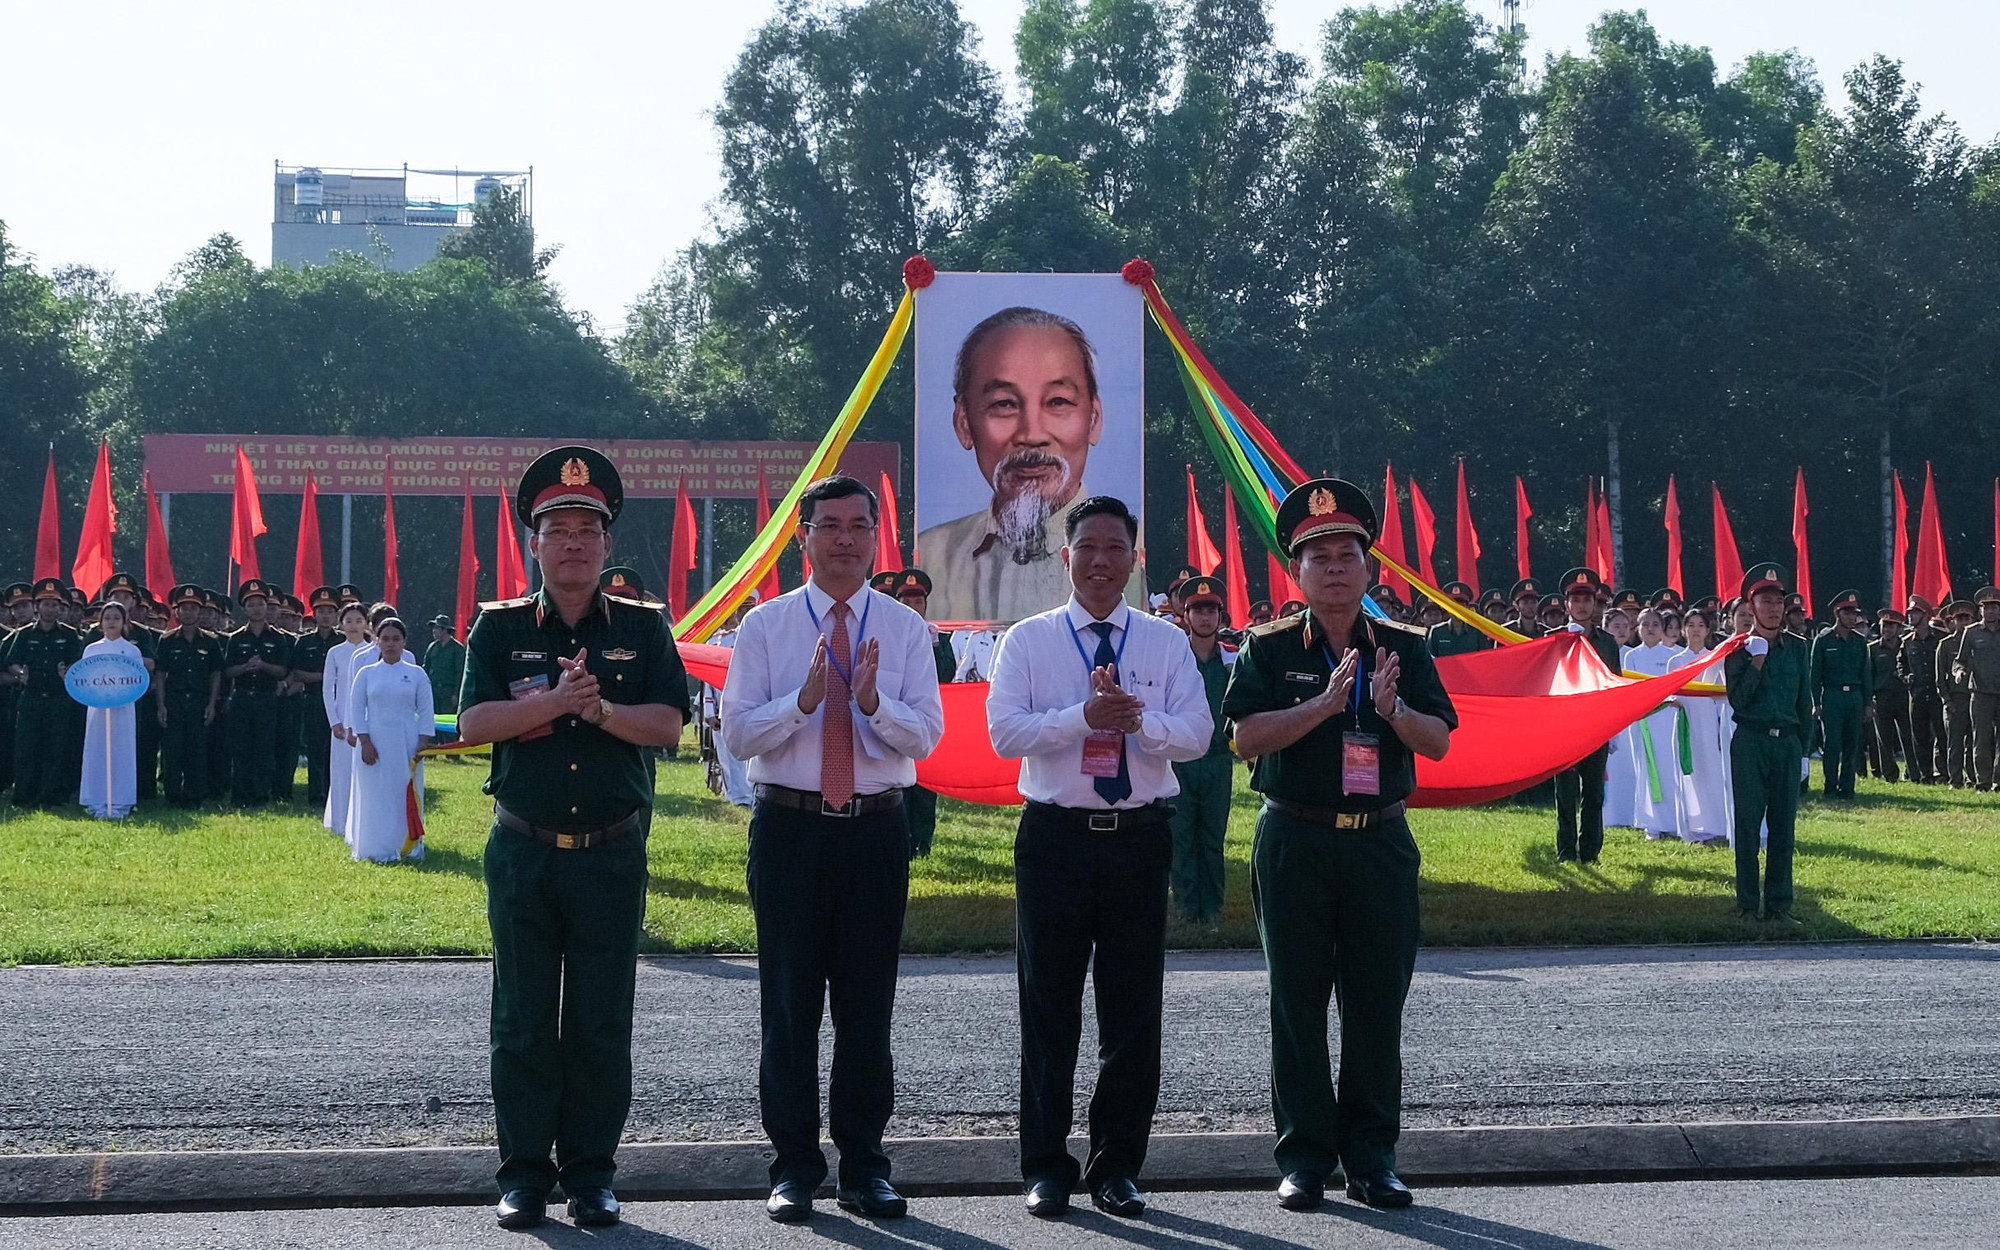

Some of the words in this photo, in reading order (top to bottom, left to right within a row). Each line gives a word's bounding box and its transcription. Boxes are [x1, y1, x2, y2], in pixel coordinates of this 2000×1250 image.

[275, 443, 319, 456] LIỆT
[326, 442, 383, 454] CHÀO
[390, 443, 455, 456] MỪNG
[462, 444, 504, 457] CÁC
[626, 446, 683, 460] ĐỘNG
[691, 447, 738, 459] VIÊN
[745, 448, 803, 460] THAM
[336, 459, 386, 470] GIÁO
[394, 460, 436, 473] DỤC
[444, 458, 500, 472] QUỐC
[621, 463, 649, 474] AN
[657, 463, 709, 474] NINH
[716, 463, 757, 476] HỌC
[764, 463, 804, 475] SIN
[210, 474, 283, 485] TRNG
[390, 474, 461, 487] THÔNG
[688, 479, 708, 489] III
[715, 477, 760, 490] NĂM
[74, 677, 90, 688] TP.
[92, 673, 116, 687] CẦN
[119, 675, 142, 686] THƠ
